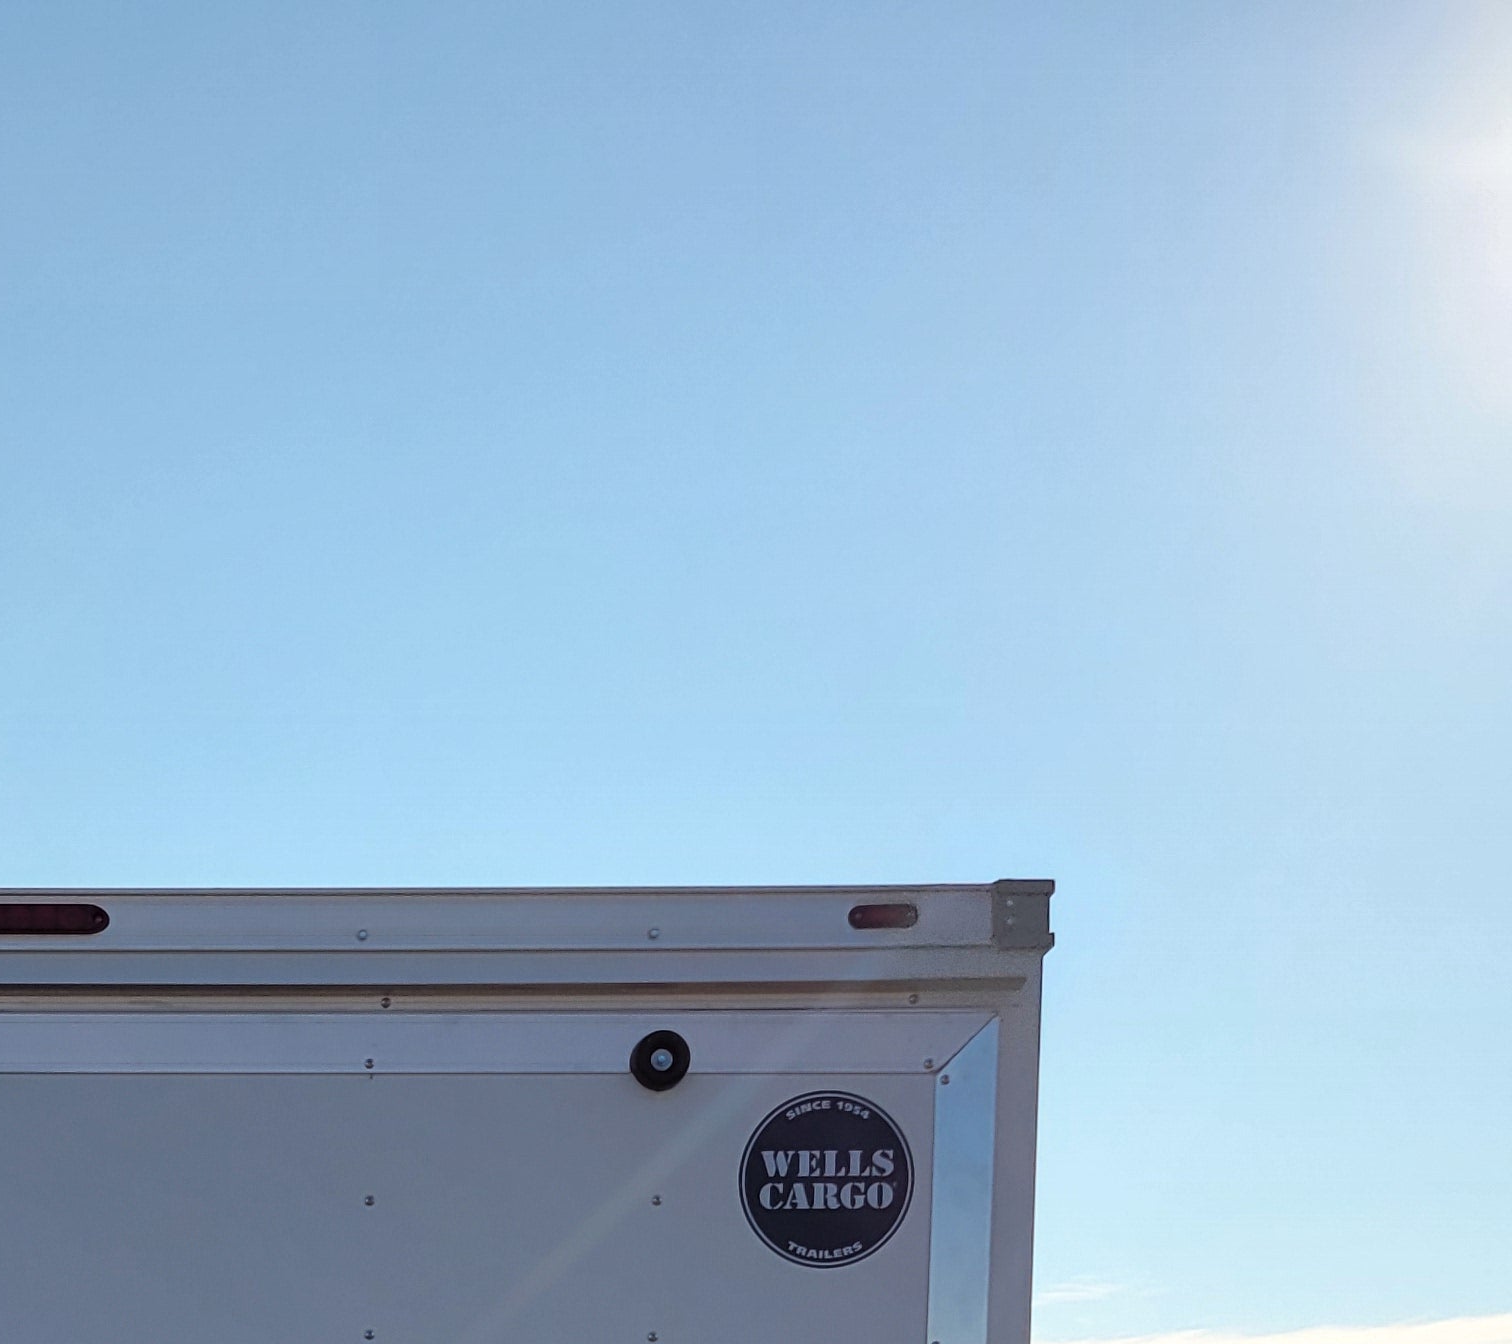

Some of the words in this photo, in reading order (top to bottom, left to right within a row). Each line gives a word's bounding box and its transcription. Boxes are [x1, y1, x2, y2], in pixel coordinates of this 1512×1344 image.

[785, 1101, 831, 1120] SINCE
[836, 1101, 870, 1120] 1954
[760, 1149, 895, 1178] WELLS
[758, 1182, 894, 1210] CARGO
[788, 1241, 863, 1259] TRAILERS
